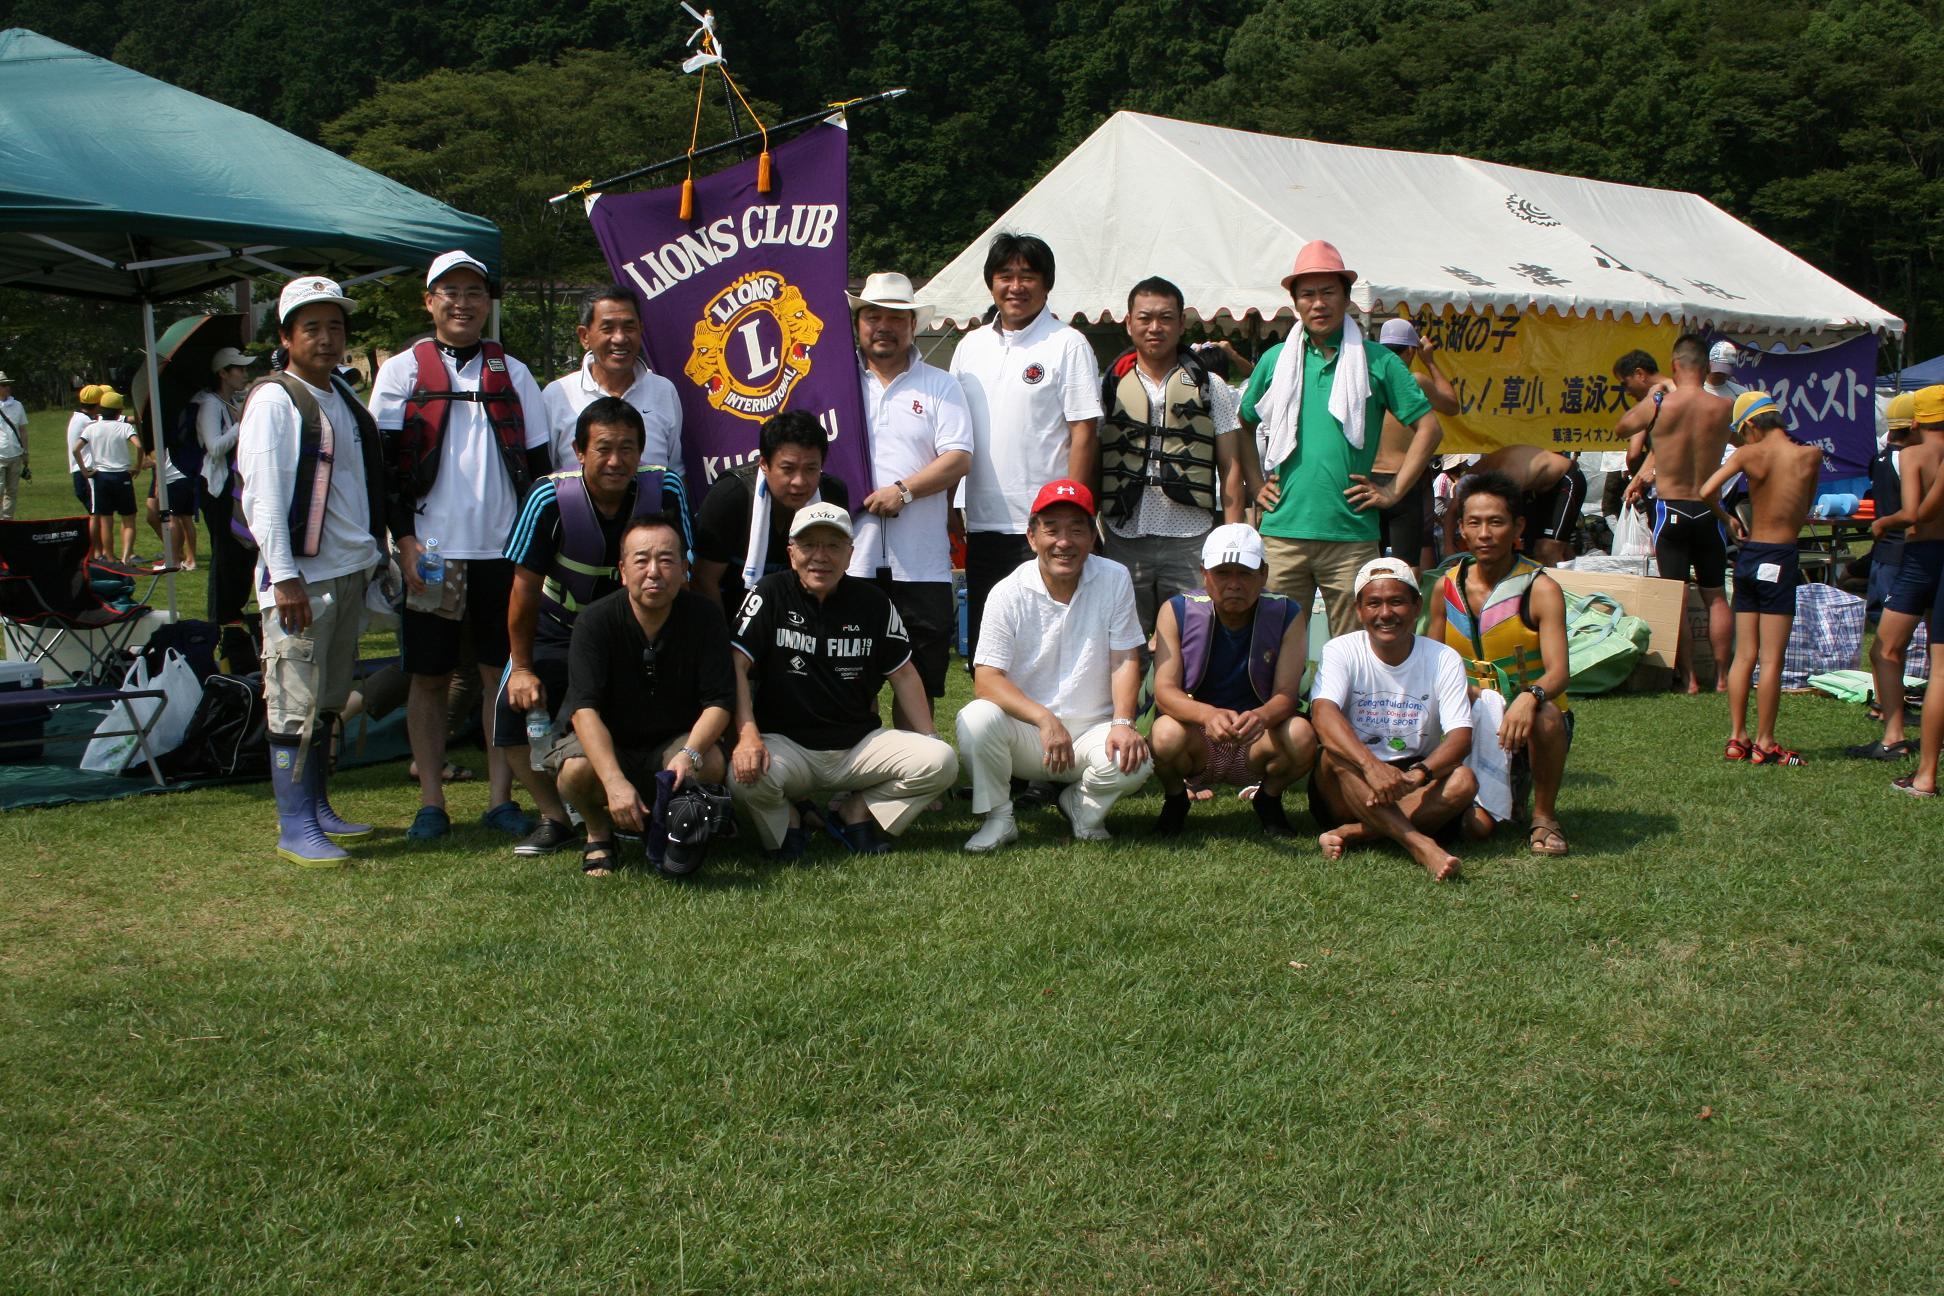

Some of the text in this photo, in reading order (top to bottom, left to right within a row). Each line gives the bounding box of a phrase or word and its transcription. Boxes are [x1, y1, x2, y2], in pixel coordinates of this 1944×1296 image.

[622, 204, 839, 300] LIONS CLUB
[711, 277, 778, 323] LIONS
[738, 318, 779, 380] L
[723, 367, 798, 413] INTERNATIONAL
[827, 638, 861, 657] FILA
[842, 624, 860, 632] FILA
[1393, 718, 1420, 726] SPORT
